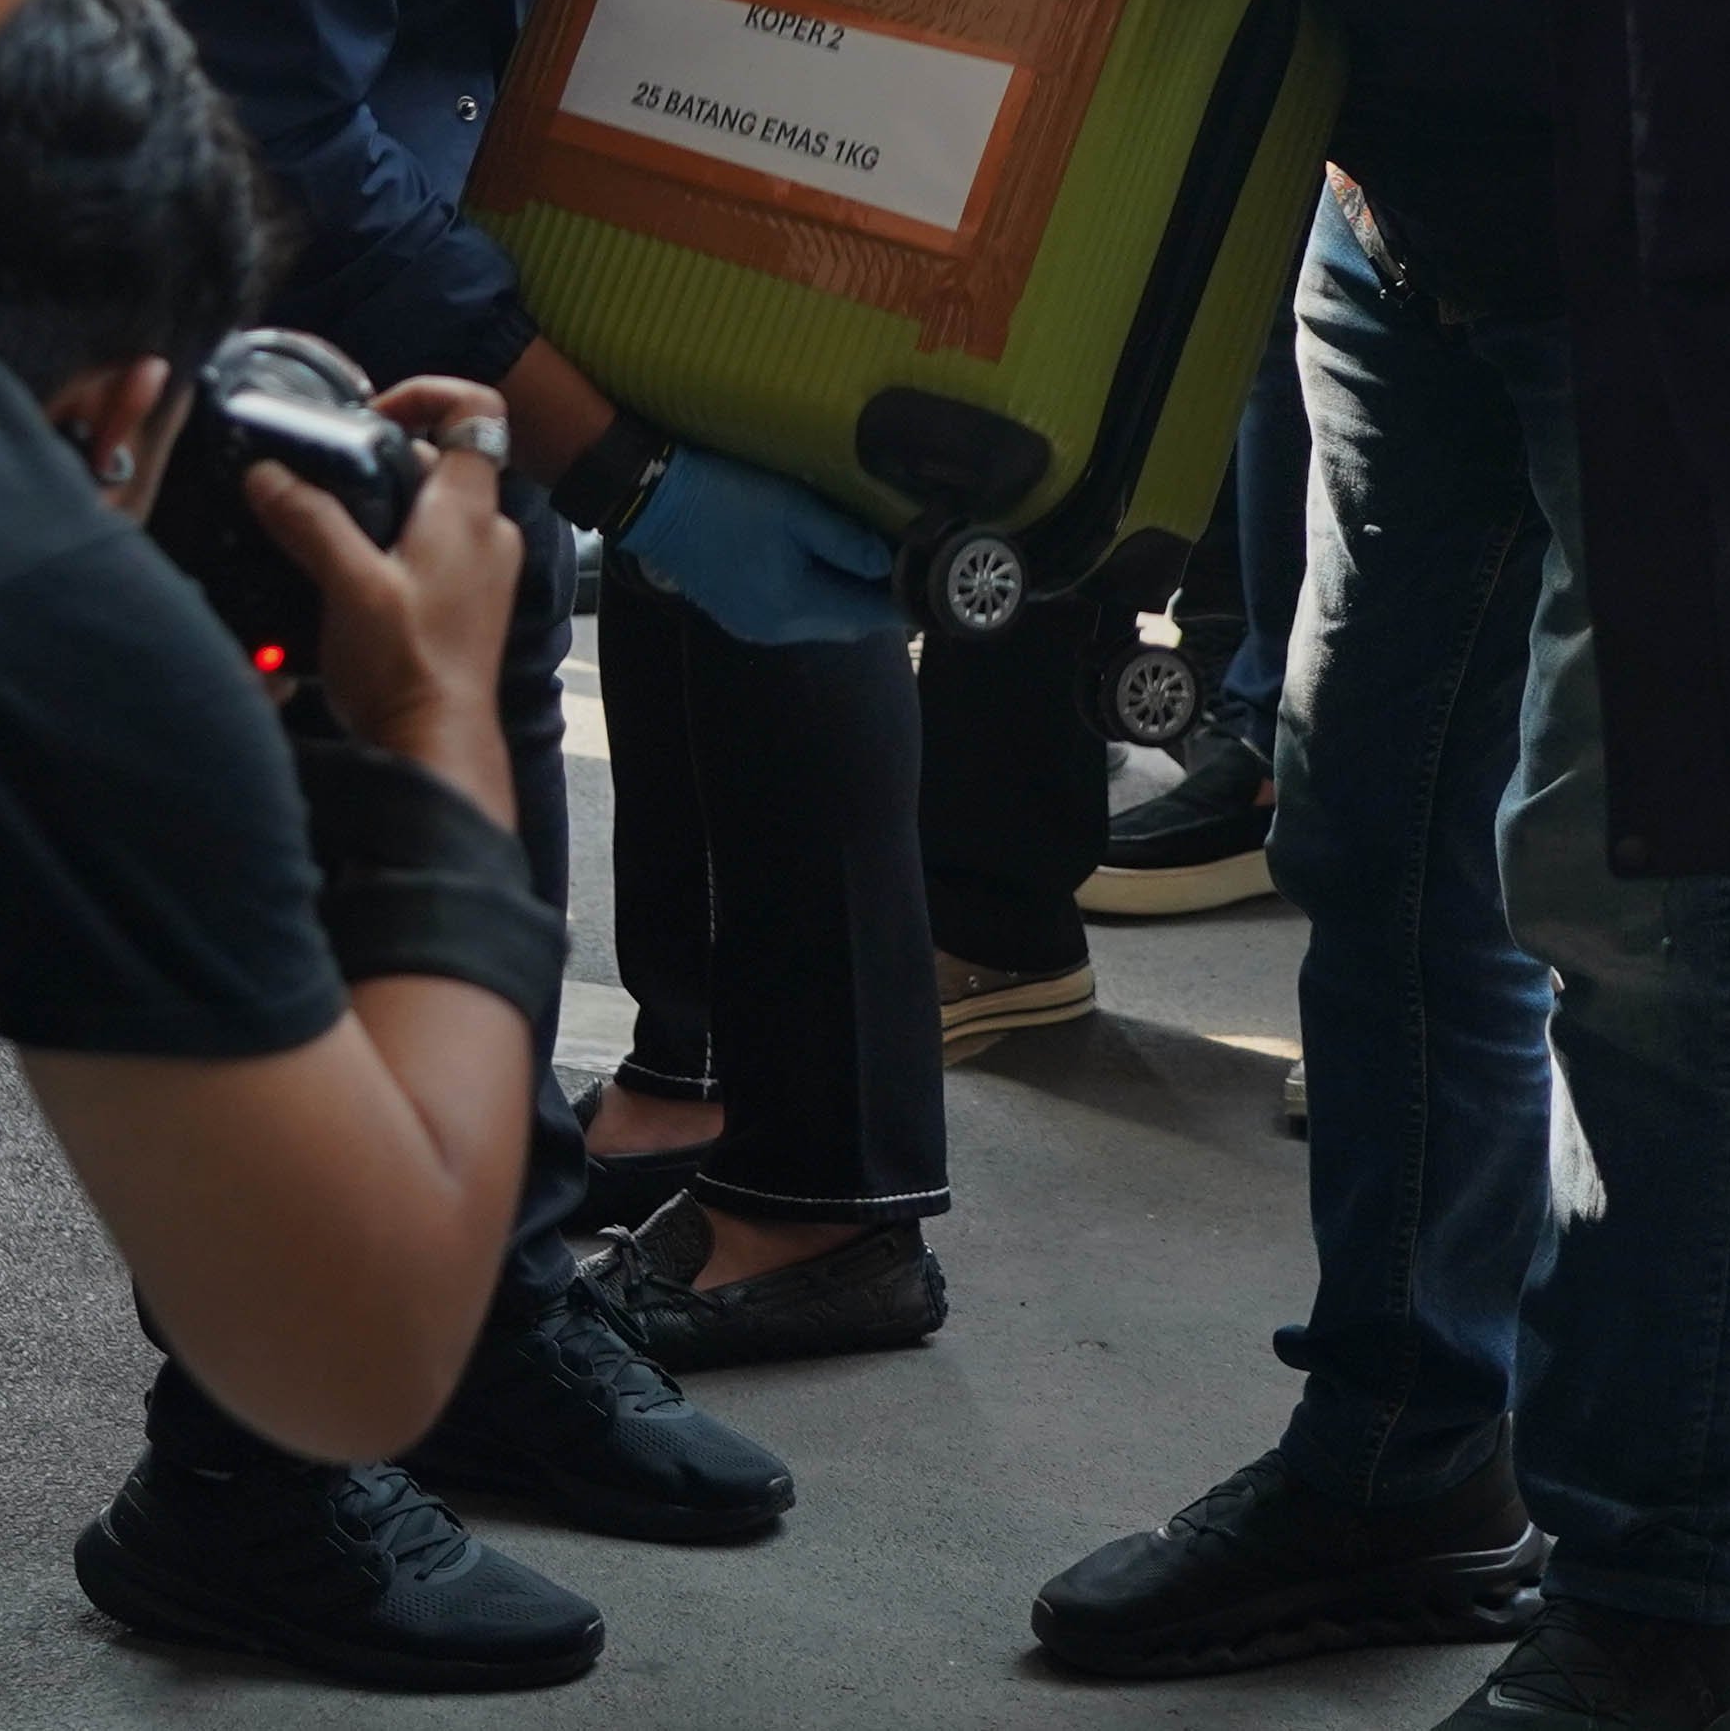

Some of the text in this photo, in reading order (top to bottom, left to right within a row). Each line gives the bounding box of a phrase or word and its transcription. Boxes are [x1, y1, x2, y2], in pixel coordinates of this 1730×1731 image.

[744, 3, 846, 51] KOPER 2
[631, 82, 881, 171] 25 BATANG EMAS 1KG
